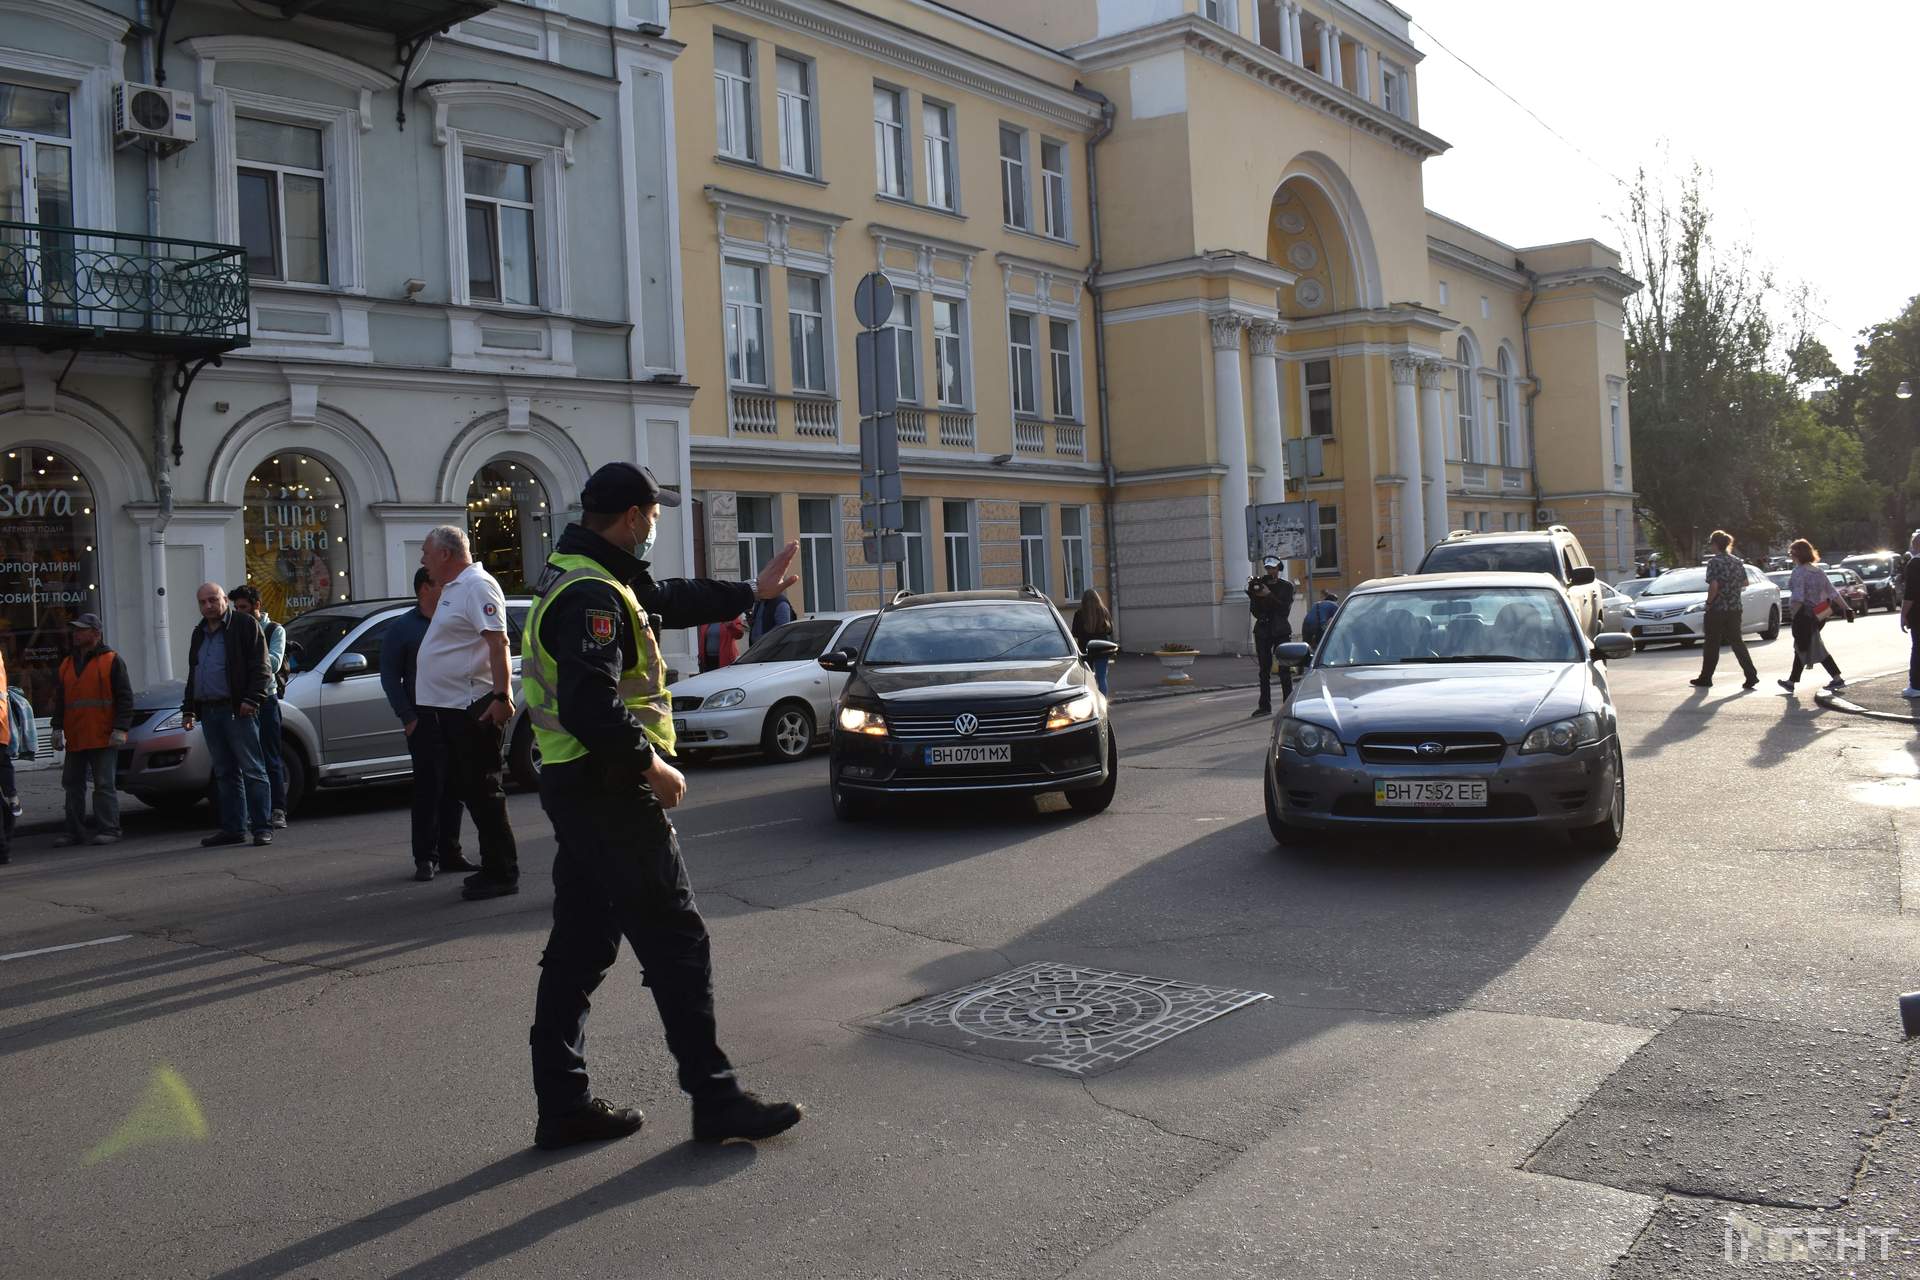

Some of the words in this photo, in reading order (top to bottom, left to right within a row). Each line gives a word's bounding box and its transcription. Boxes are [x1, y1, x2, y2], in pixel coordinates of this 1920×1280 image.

[0, 484, 77, 518] Sova
[27, 577, 43, 588] ТА
[286, 597, 315, 608] КВІТИ
[932, 749, 953, 763] BH
[955, 747, 987, 762] 0701
[989, 746, 1009, 761] MX
[1386, 783, 1411, 800] BH
[1414, 783, 1454, 800] 7552
